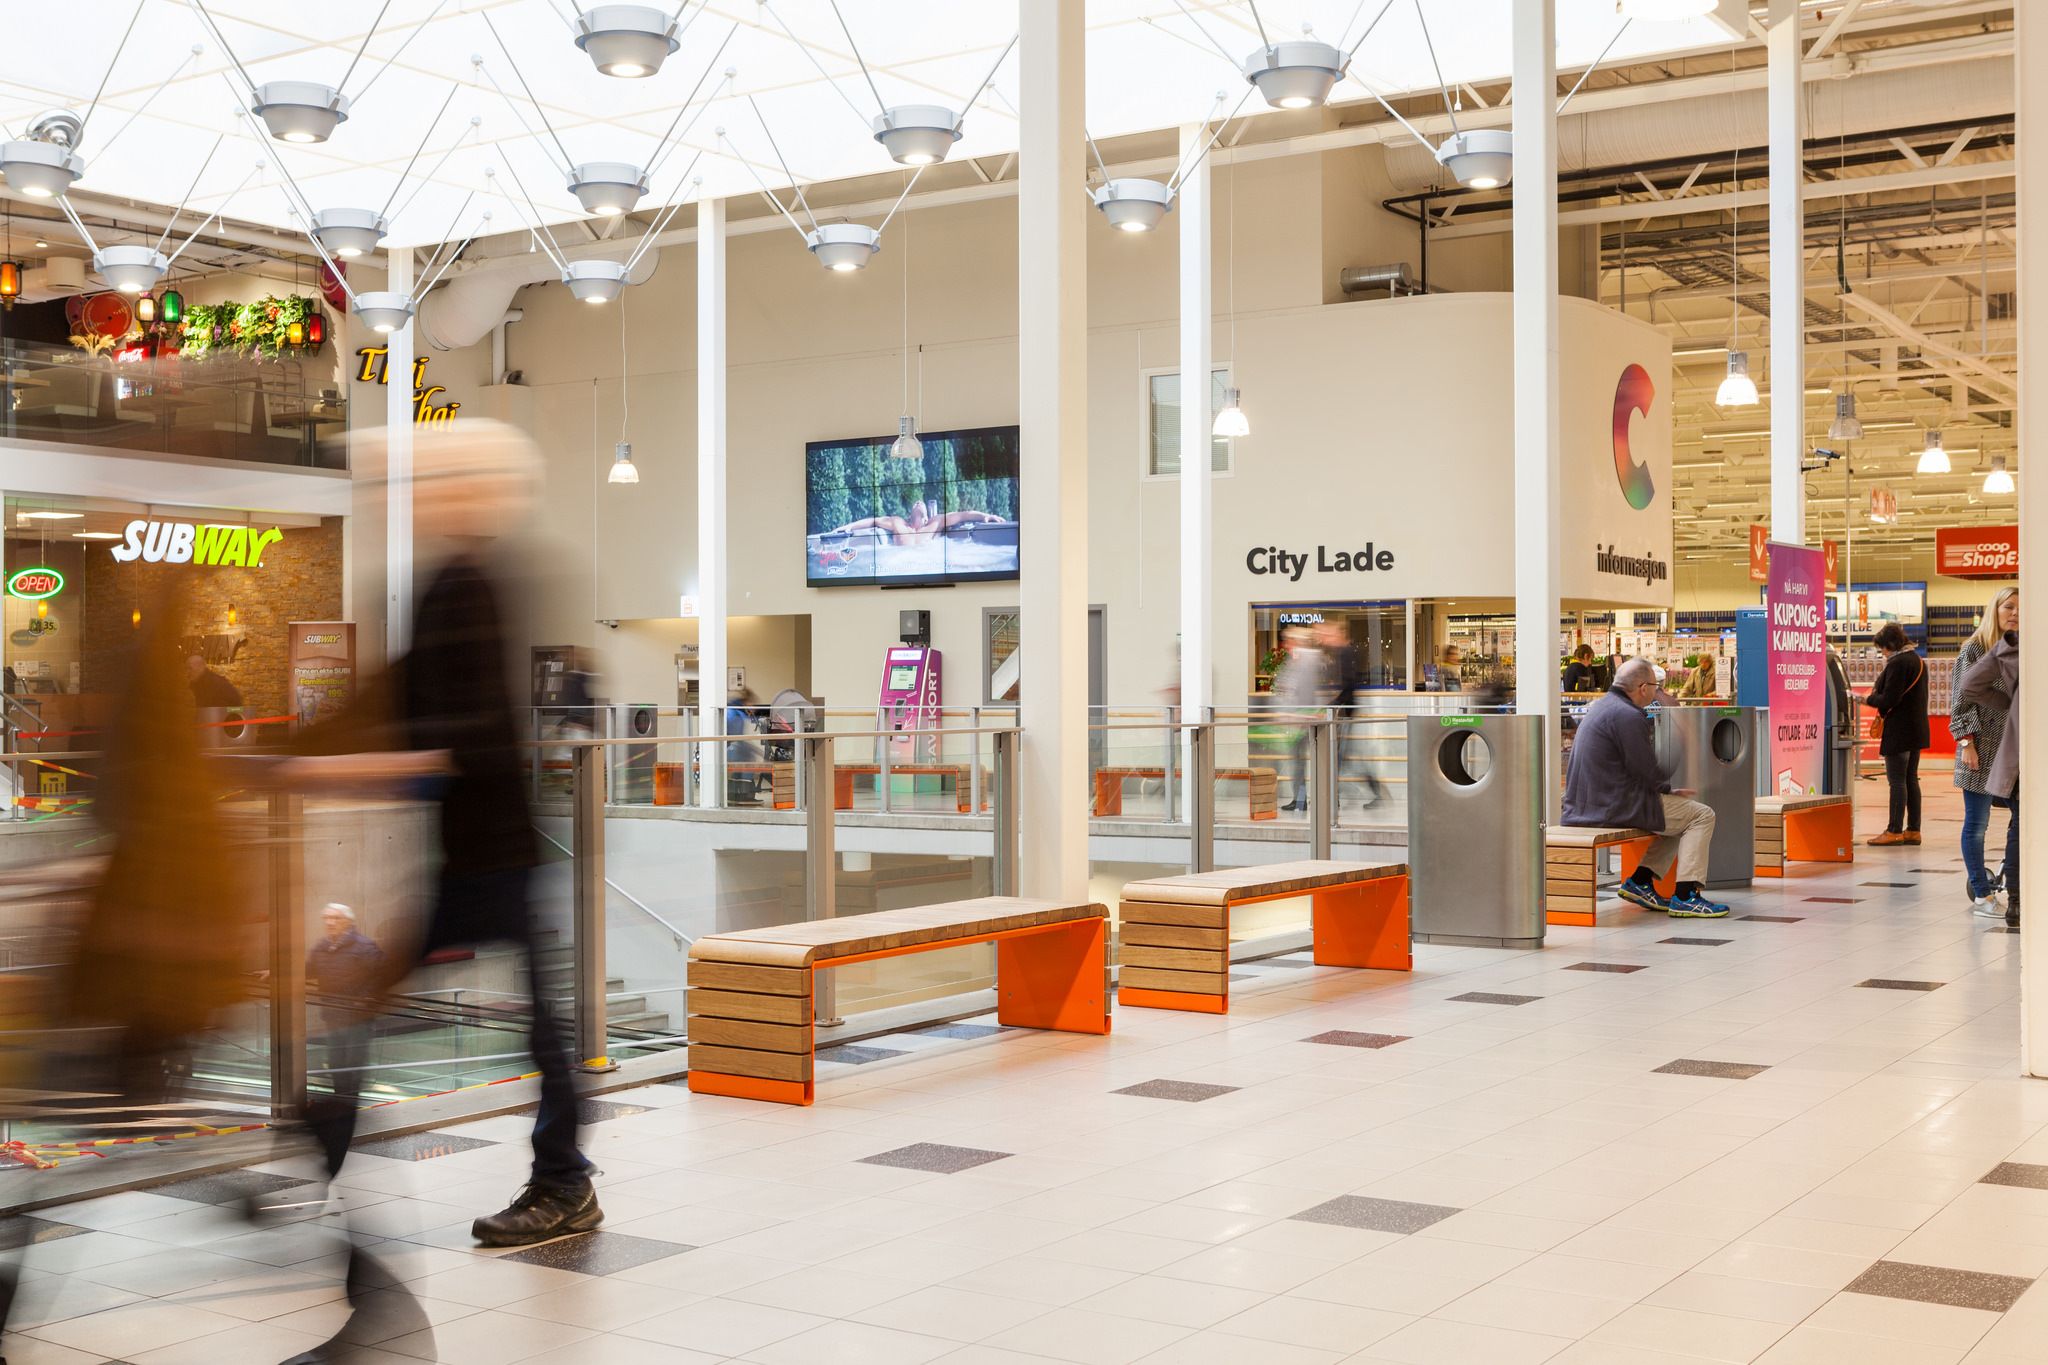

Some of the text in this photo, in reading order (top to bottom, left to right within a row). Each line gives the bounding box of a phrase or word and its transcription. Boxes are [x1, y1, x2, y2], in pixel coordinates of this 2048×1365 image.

[412, 386, 461, 432] hai
[110, 520, 284, 568] SUBWAY
[1976, 543, 2010, 552] coop
[1247, 542, 1394, 581] City Lade
[1597, 544, 1667, 585] informasjon
[16, 576, 56, 592] OPEN
[1773, 602, 1821, 628] KUPONG-
[304, 634, 342, 644] SUBWAY
[1831, 623, 1839, 632] &
[1773, 630, 1822, 653] KAMPANJE
